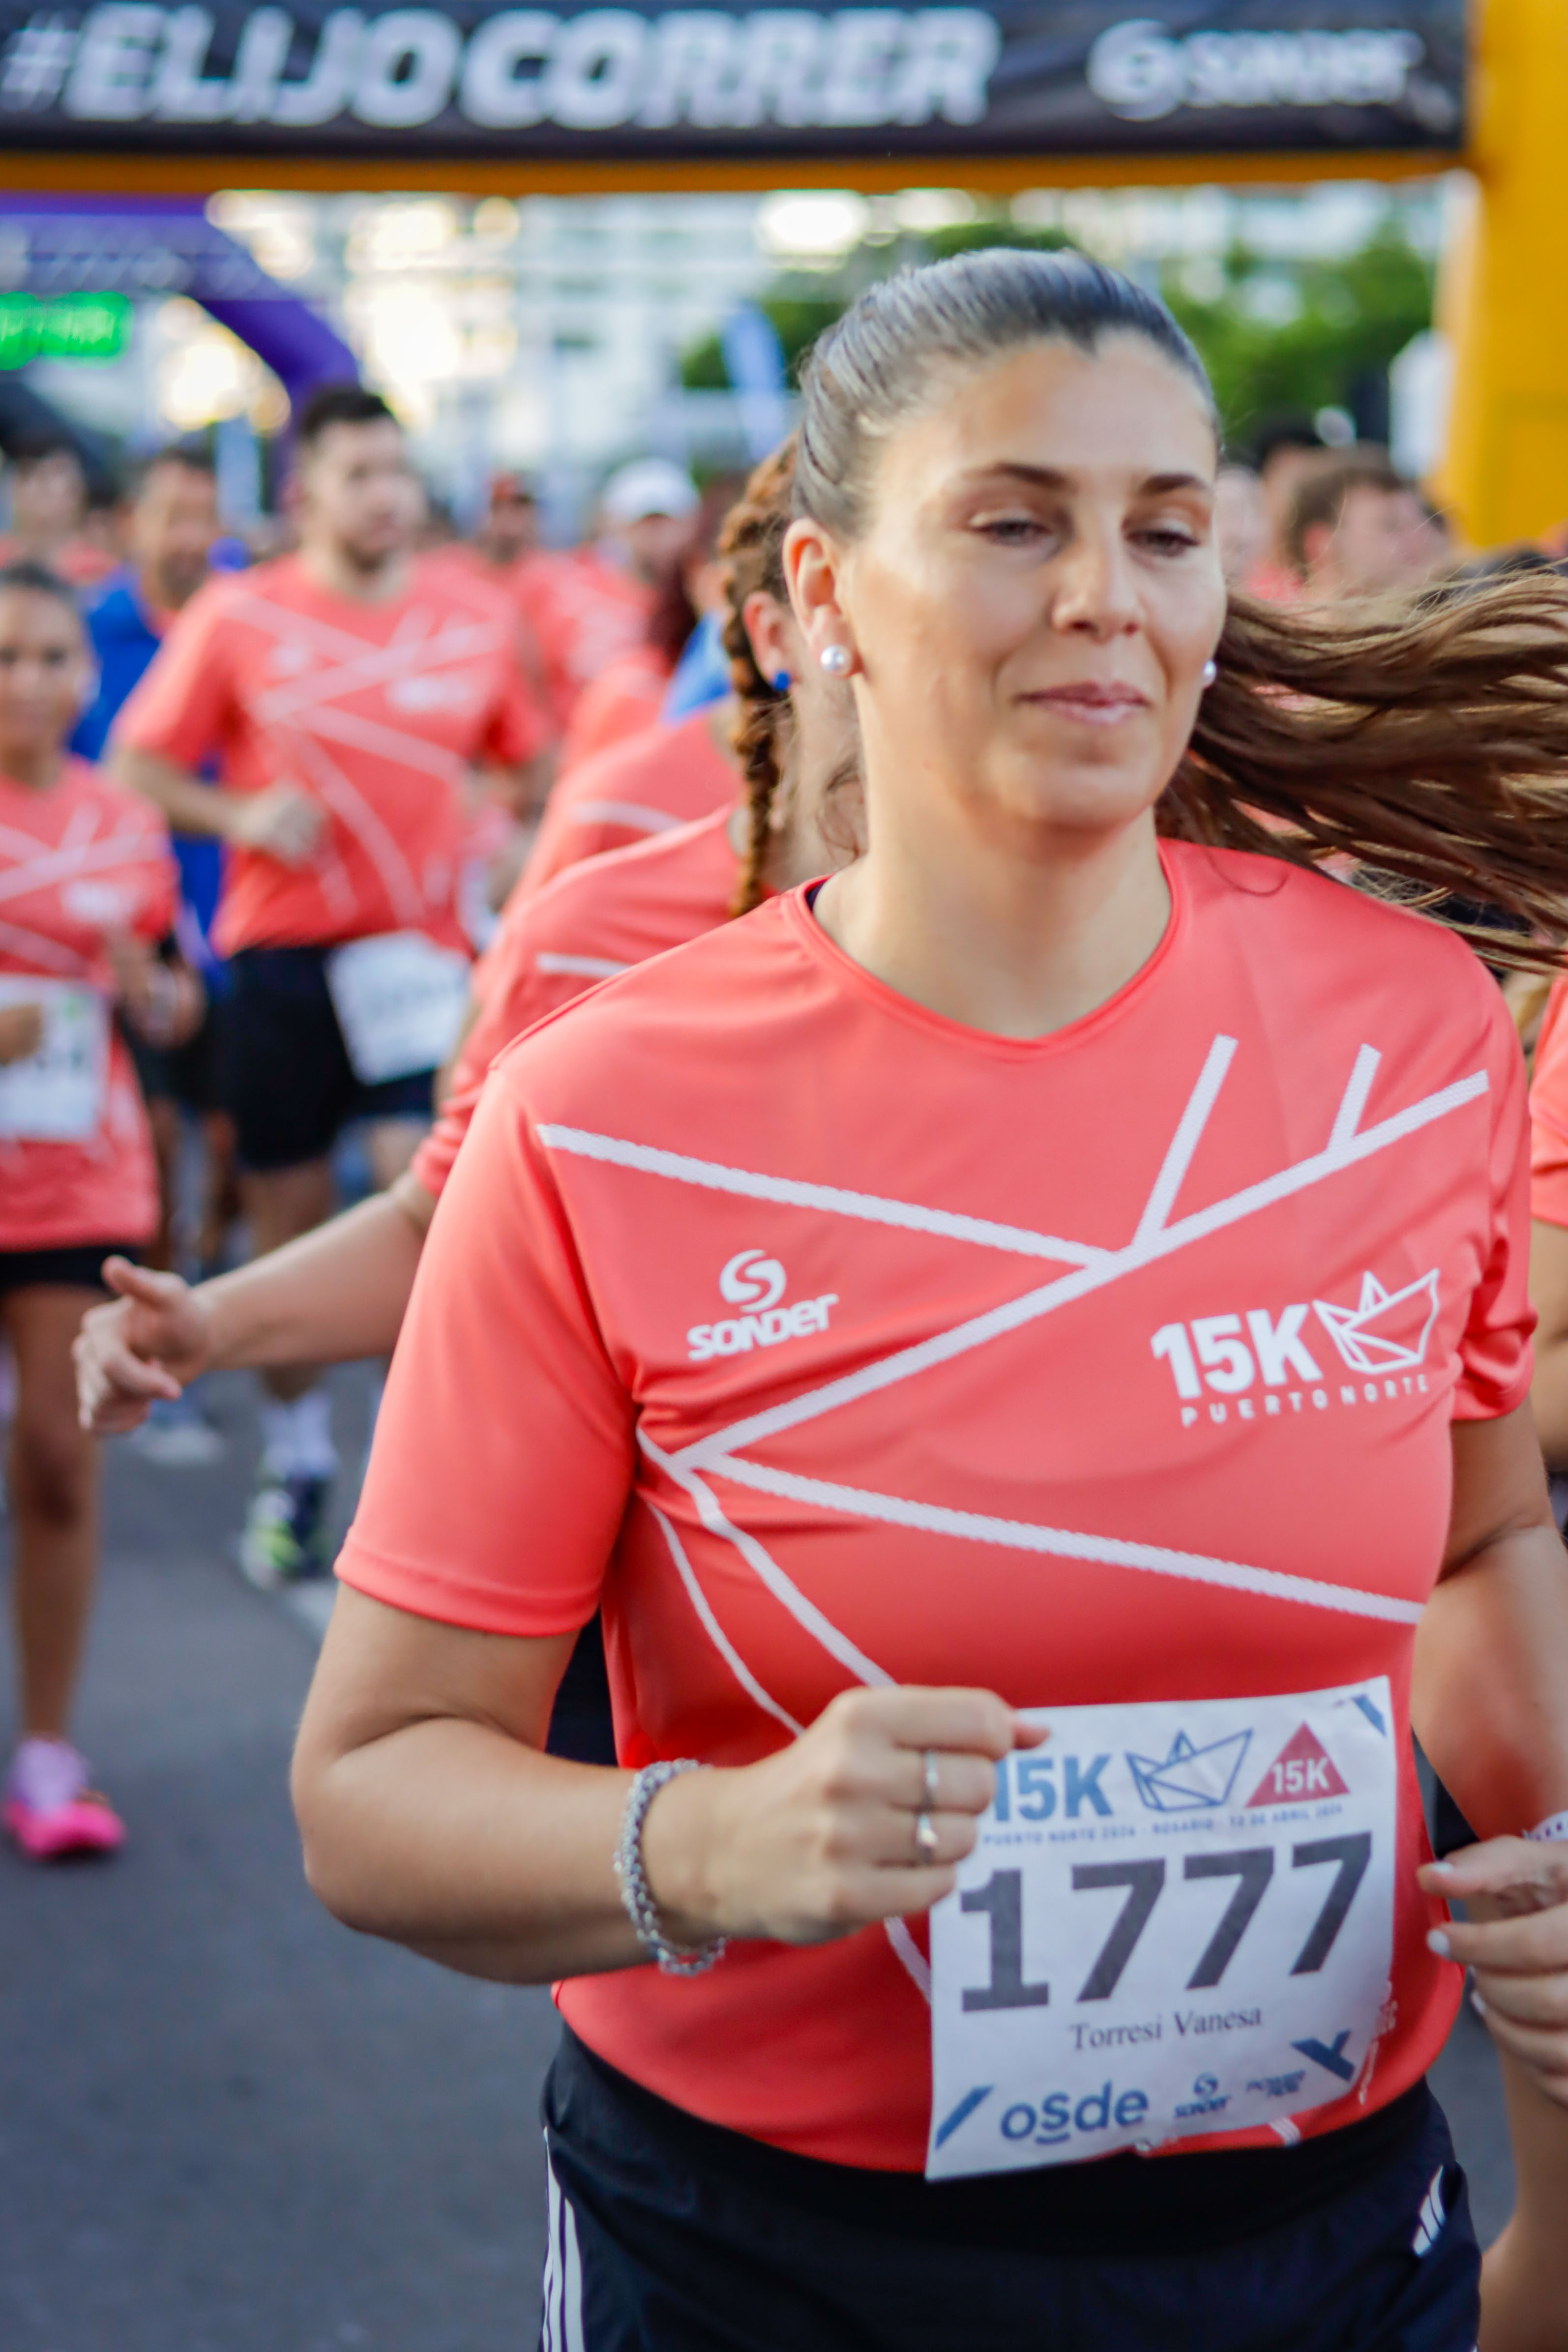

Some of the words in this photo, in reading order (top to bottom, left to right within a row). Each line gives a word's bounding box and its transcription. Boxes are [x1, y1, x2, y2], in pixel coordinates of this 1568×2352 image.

[1150, 1303, 1324, 1399] 15K
[1181, 1388, 1328, 1427] PUERTO
[1340, 1374, 1428, 1405] NORTE
[992, 1752, 1114, 1823] 15K
[1270, 1756, 1329, 1794] 15K
[959, 1831, 1372, 2013] 1777
[1069, 2013, 1162, 2050] Torresi
[1173, 2007, 1262, 2036] Vanesa
[1001, 2079, 1149, 2145] osde
